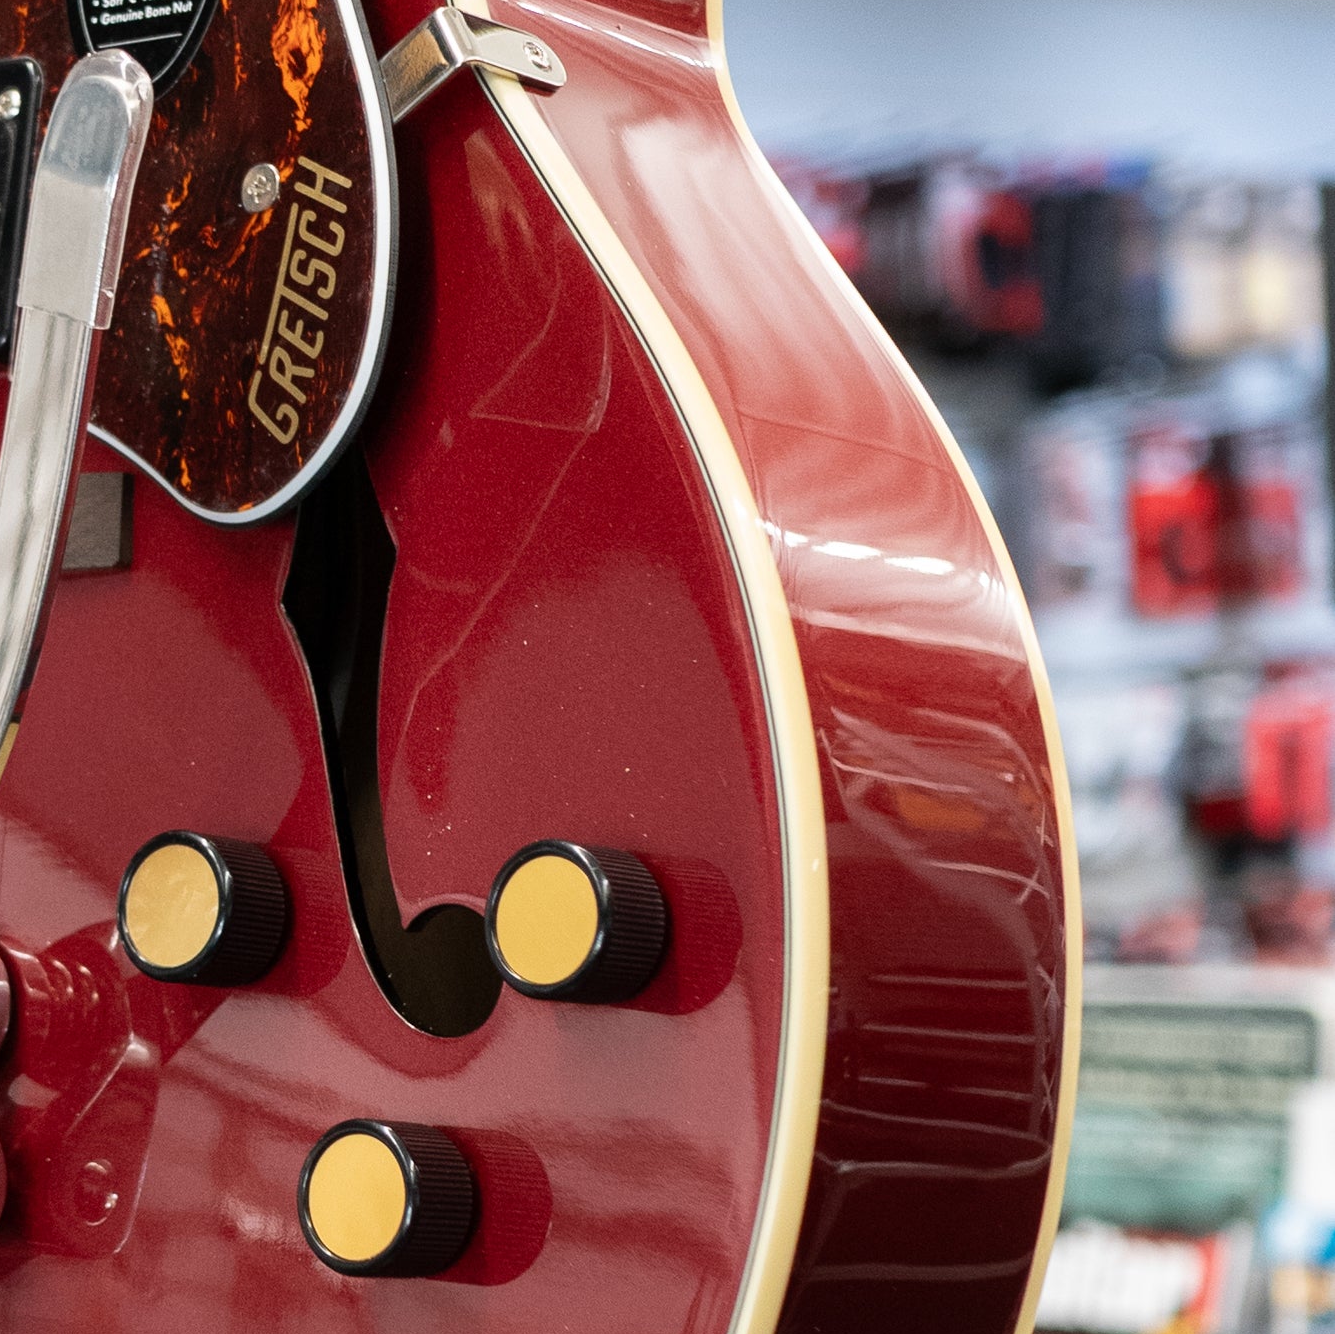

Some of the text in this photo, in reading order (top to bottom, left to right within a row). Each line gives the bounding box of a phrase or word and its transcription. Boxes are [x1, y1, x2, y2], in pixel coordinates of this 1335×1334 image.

[100, 0, 193, 25] Genuine Bone Nut
[247, 155, 353, 445] GRETSCH
